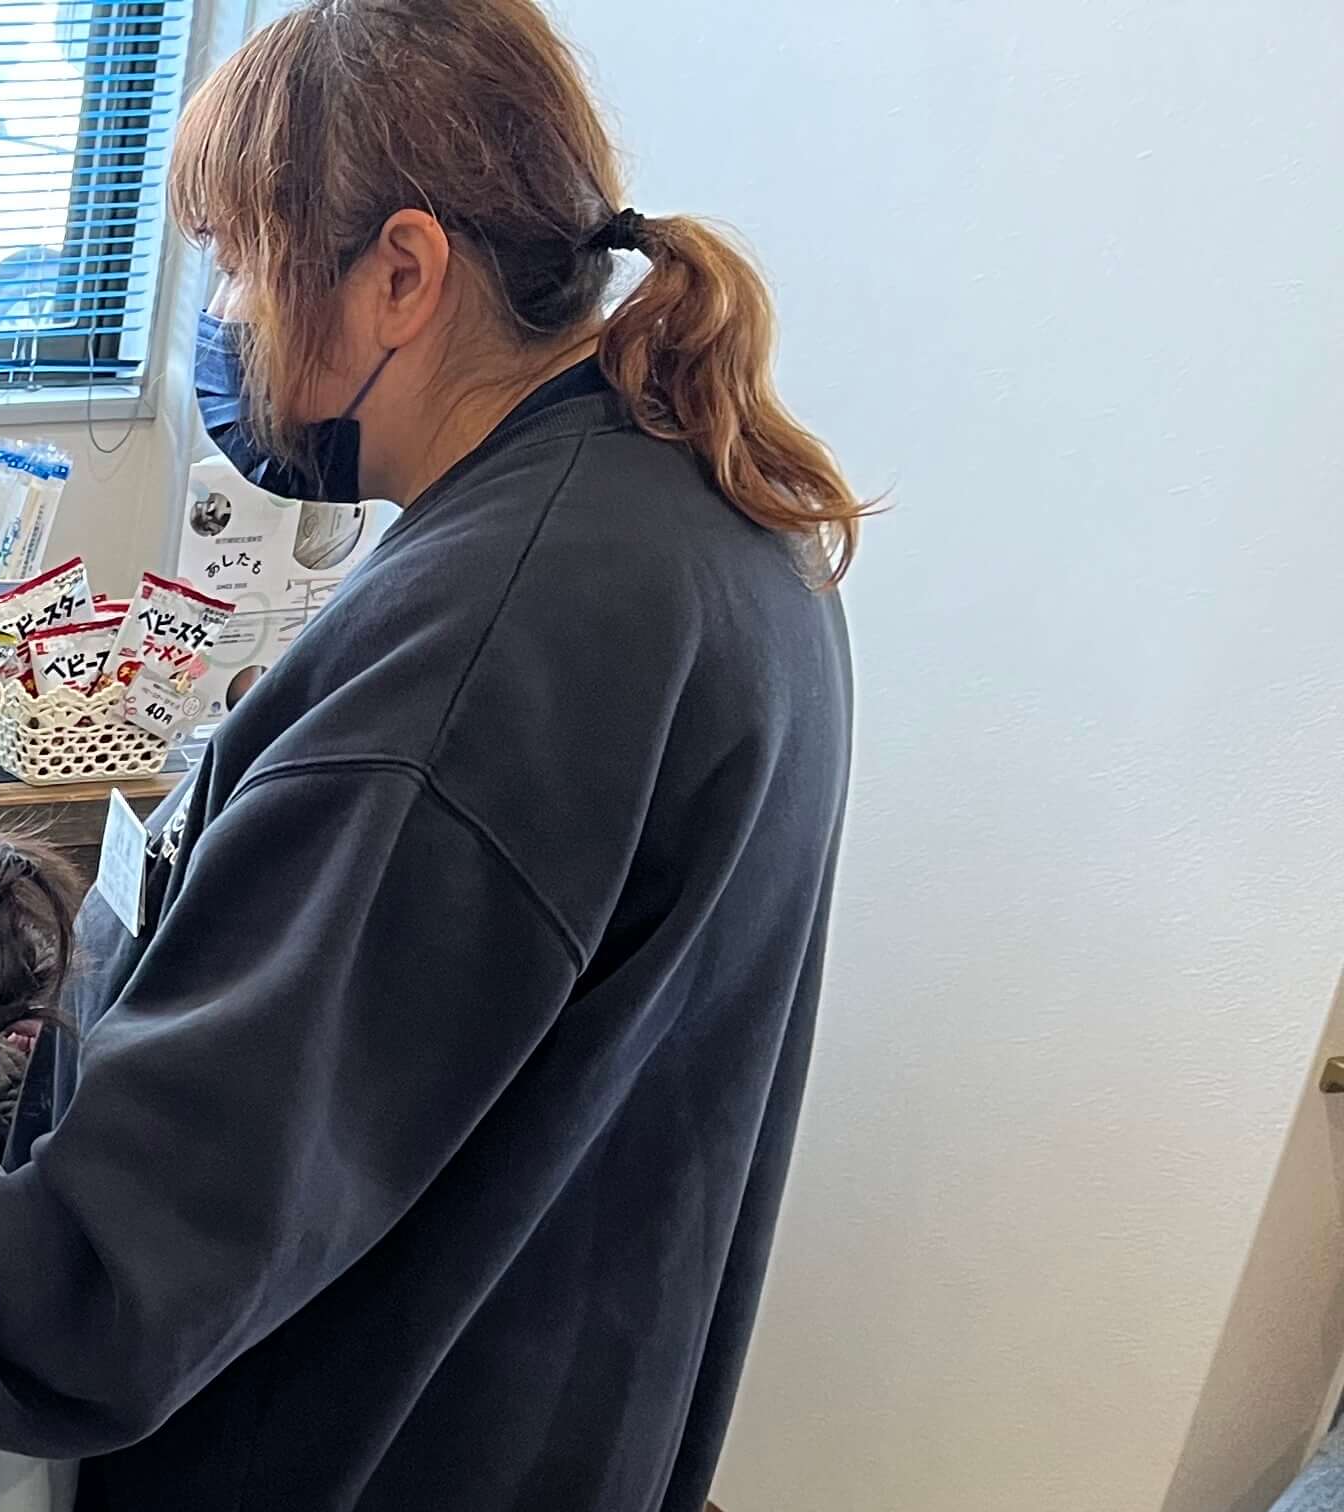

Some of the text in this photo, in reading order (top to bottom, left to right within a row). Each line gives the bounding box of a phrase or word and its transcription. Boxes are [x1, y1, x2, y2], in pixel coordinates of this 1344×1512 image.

[204, 552, 262, 578] あしたも
[137, 607, 214, 649] ベビースター
[143, 635, 194, 667] ラーメン
